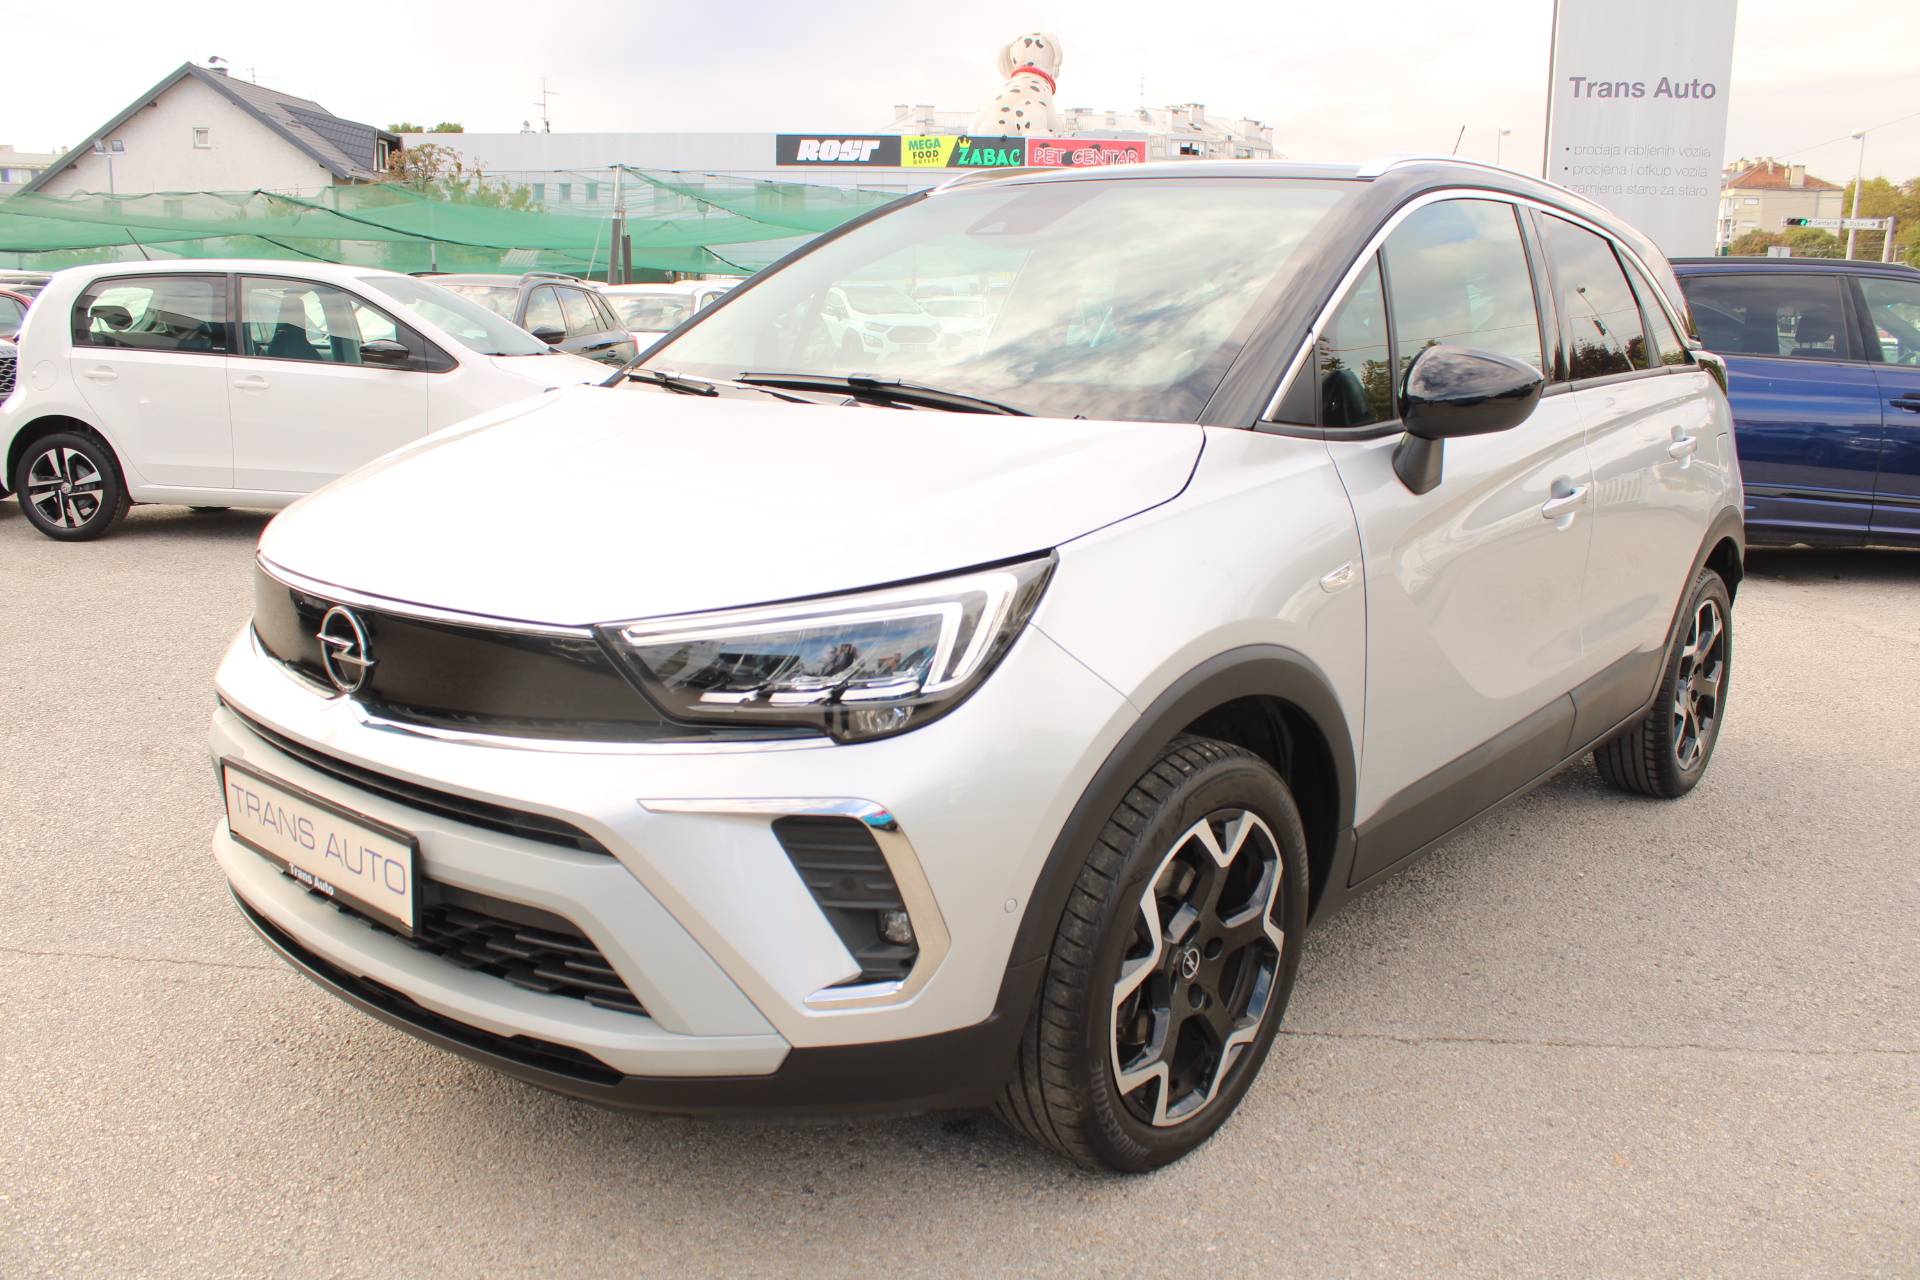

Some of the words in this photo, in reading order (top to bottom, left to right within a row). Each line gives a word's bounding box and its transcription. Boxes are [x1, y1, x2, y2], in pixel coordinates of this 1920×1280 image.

[1569, 77, 1646, 98] Trans
[1653, 77, 1716, 99] Auto
[797, 139, 880, 161] ROST
[908, 139, 941, 150] MEGA
[1574, 144, 1621, 157] prodaja
[1624, 144, 1675, 158] rabljenih
[1678, 145, 1711, 158] vozila
[912, 150, 939, 159] FOOD
[1034, 147, 1066, 164] PET
[1071, 148, 1139, 165] CENTAR
[1572, 164, 1626, 178] procjena
[1637, 165, 1672, 178] otkup
[1675, 165, 1708, 177] vozila
[1571, 183, 1623, 196] zamjena
[1625, 184, 1656, 195] staro
[1661, 186, 1674, 196] za
[1678, 185, 1708, 196] staro
[231, 783, 316, 851] TRANS
[325, 832, 406, 896] AUTO
[289, 863, 313, 885] Trans
[314, 876, 335, 896] Auto
